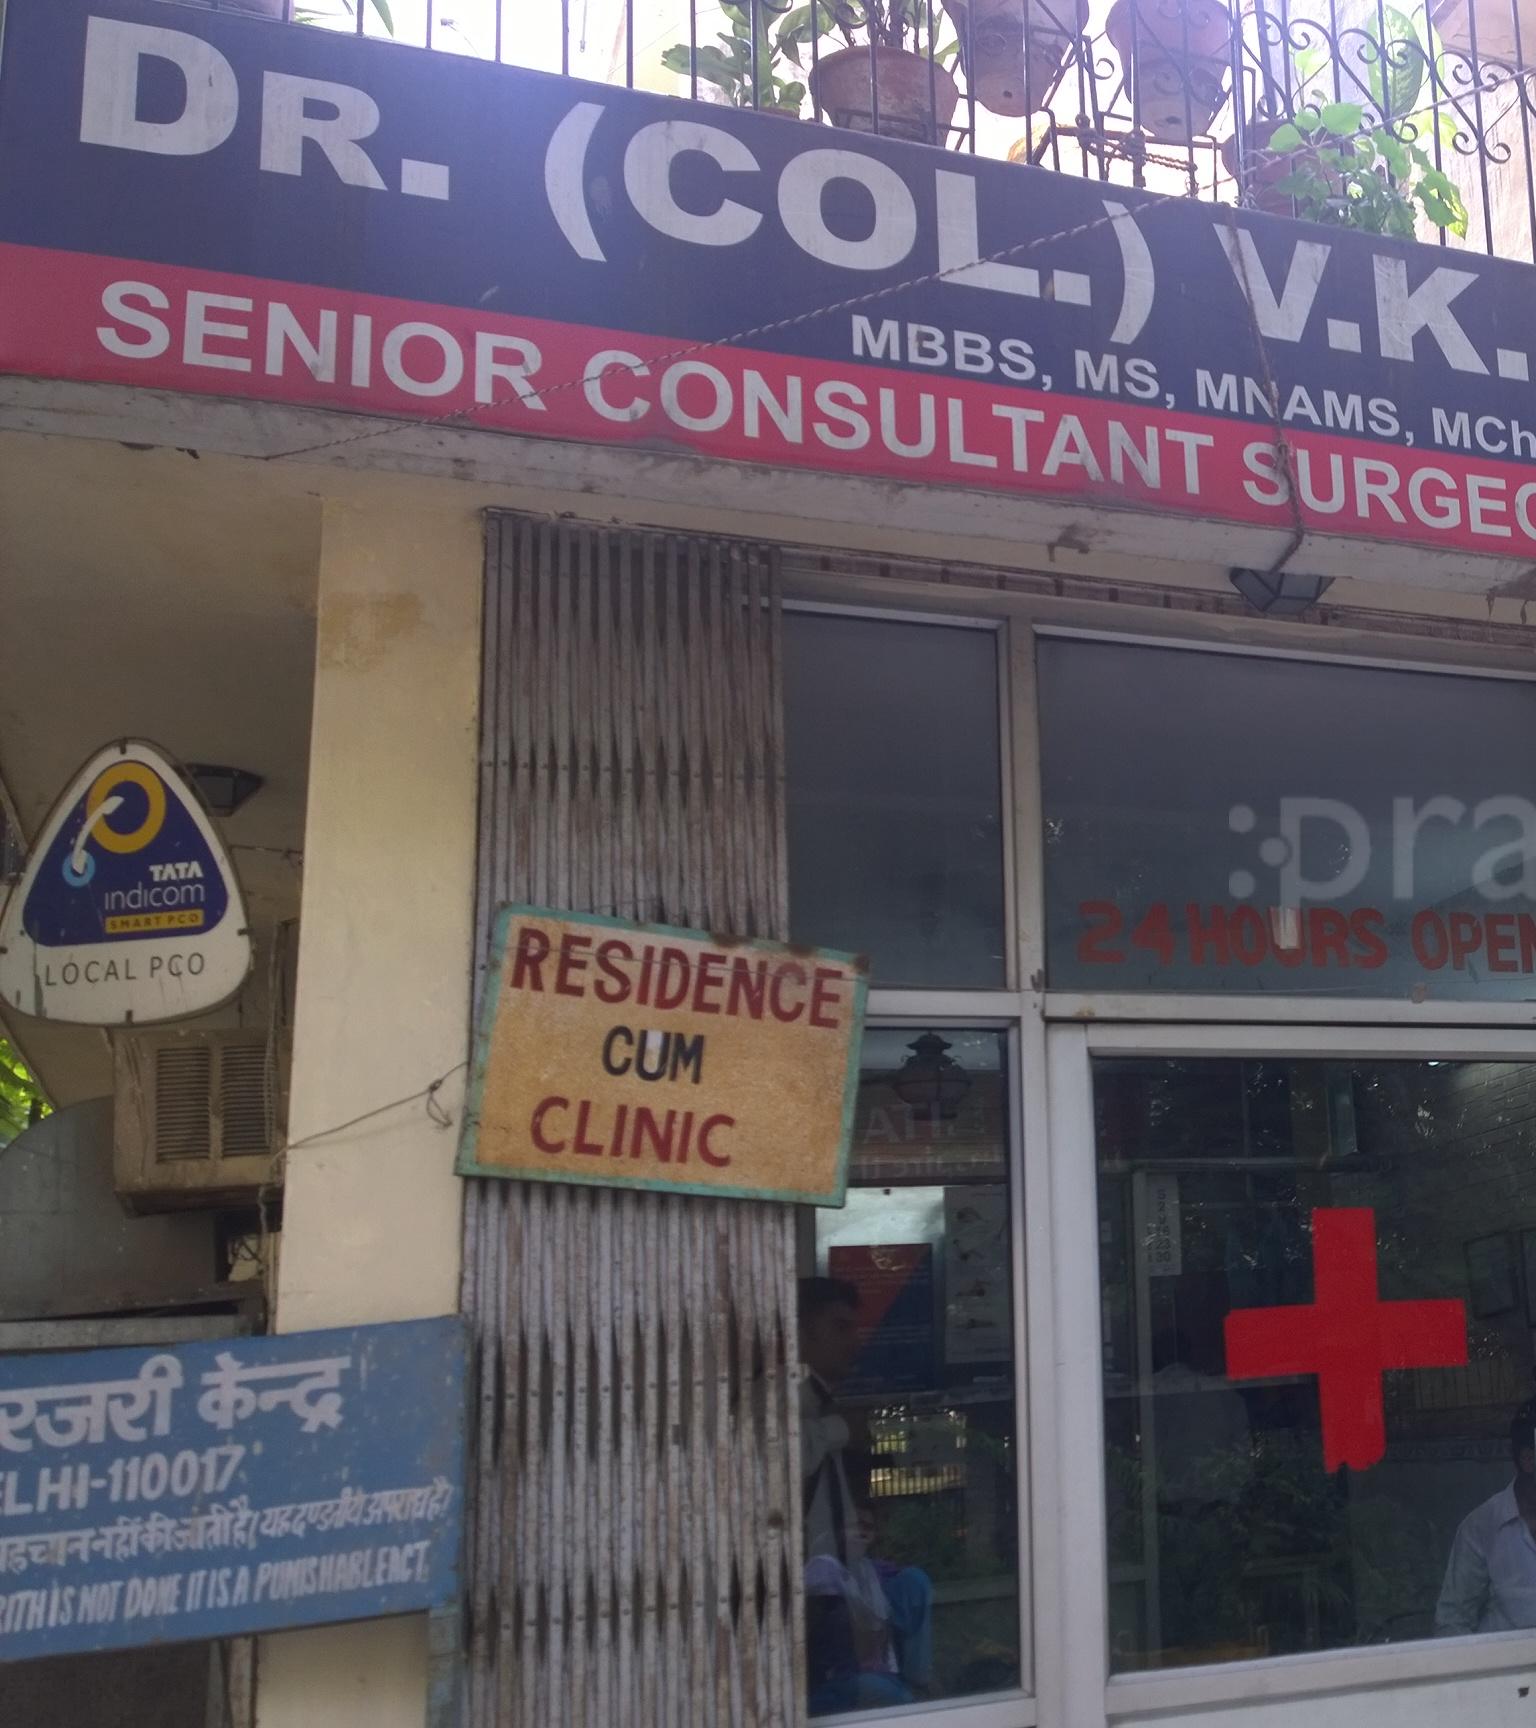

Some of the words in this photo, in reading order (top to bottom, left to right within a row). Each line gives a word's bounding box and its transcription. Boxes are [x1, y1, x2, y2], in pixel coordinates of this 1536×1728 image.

[79, 15, 449, 200] DR.
[545, 102, 1155, 344] (COL.)
[1214, 223, 1529, 382] V.K.
[96, 280, 547, 411] SENIOR
[584, 350, 1213, 496] CONSULTANT
[851, 314, 1053, 391] MBBS,
[1074, 350, 1175, 409] MS,
[1196, 368, 1414, 447] MNAMS,
[105, 882, 205, 910] indicom
[150, 861, 203, 882] TATA
[110, 915, 161, 930] SMART
[168, 913, 200, 925] PCO
[1077, 901, 1175, 966] 24
[1187, 904, 1388, 970] HOURS
[45, 958, 137, 986] LOCAL
[151, 953, 205, 978] PCO
[510, 927, 842, 1029] RESIDENCE
[602, 1025, 704, 1084] CUM
[530, 1096, 735, 1168] CLINIC
[0, 1445, 245, 1516] LHI-110017
[48, 1583, 75, 1626] IS
[77, 1581, 124, 1623] NOT
[124, 1574, 182, 1619] DONE
[185, 1570, 208, 1612] IT
[207, 1568, 232, 1608] IS
[232, 1565, 249, 1606] A
[252, 1547, 390, 1603] PUNISHABLE
